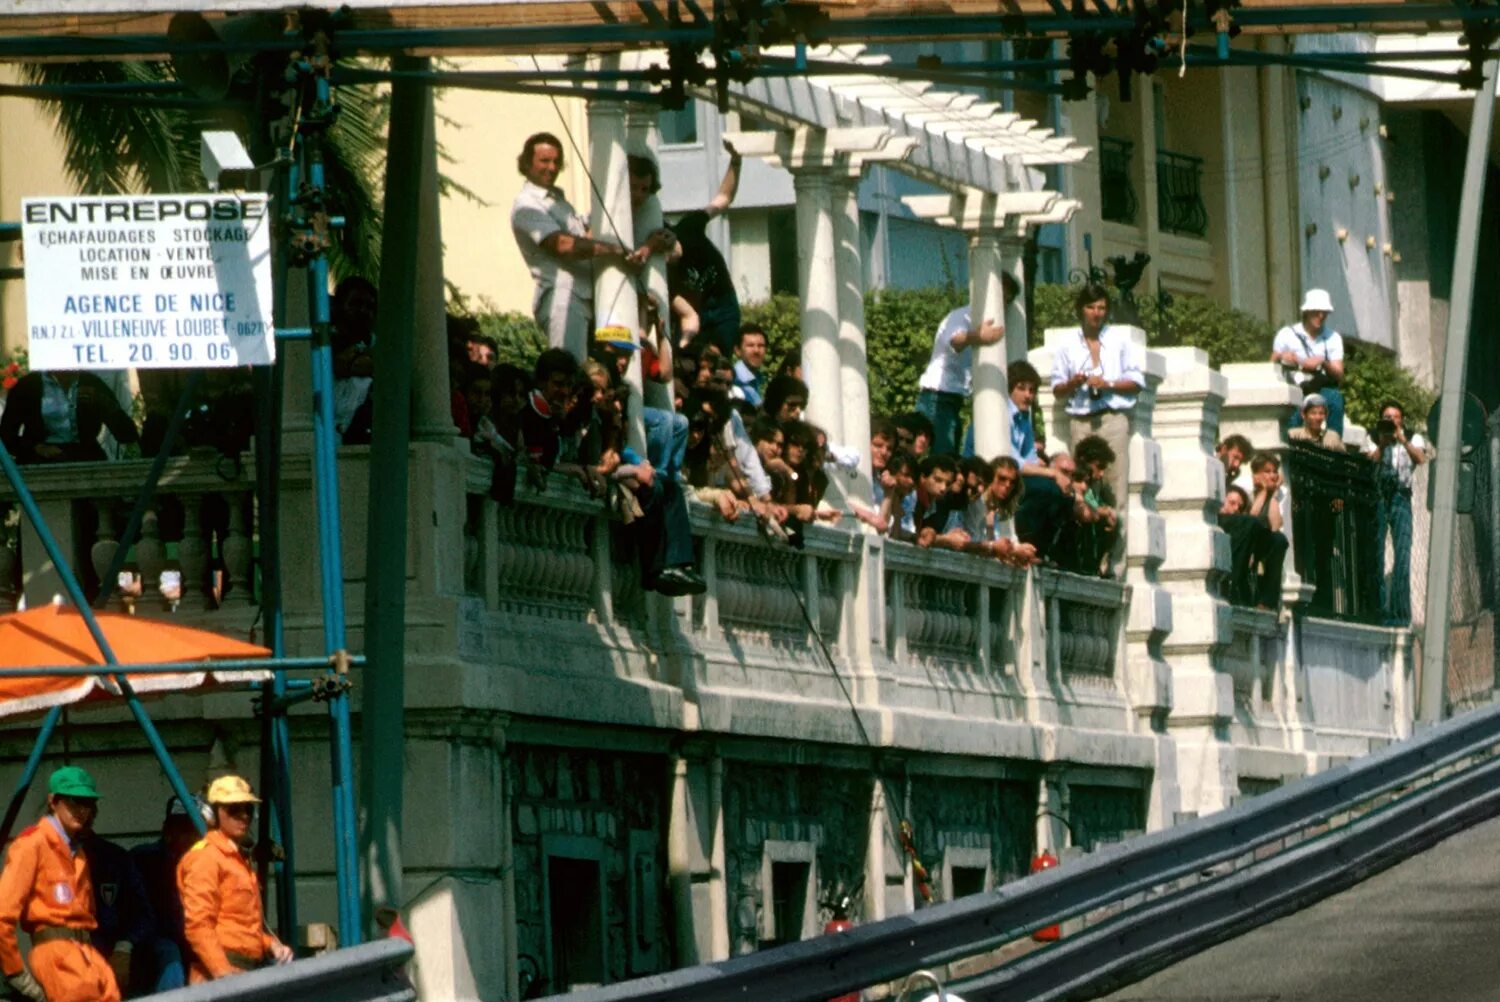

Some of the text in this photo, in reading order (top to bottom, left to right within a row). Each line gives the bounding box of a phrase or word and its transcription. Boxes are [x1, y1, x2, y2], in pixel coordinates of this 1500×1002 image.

[26, 199, 263, 223] ENTREPOSE
[39, 229, 156, 245] ECHAFAUDAGES
[80, 247, 151, 262] LOCATION
[81, 266, 118, 280] MISE
[131, 265, 149, 280] EN
[64, 291, 236, 314] AGENCE DE NICE
[82, 318, 167, 338] VILLENEUVE
[176, 317, 231, 337] LOUBET
[207, 340, 230, 361] 06
